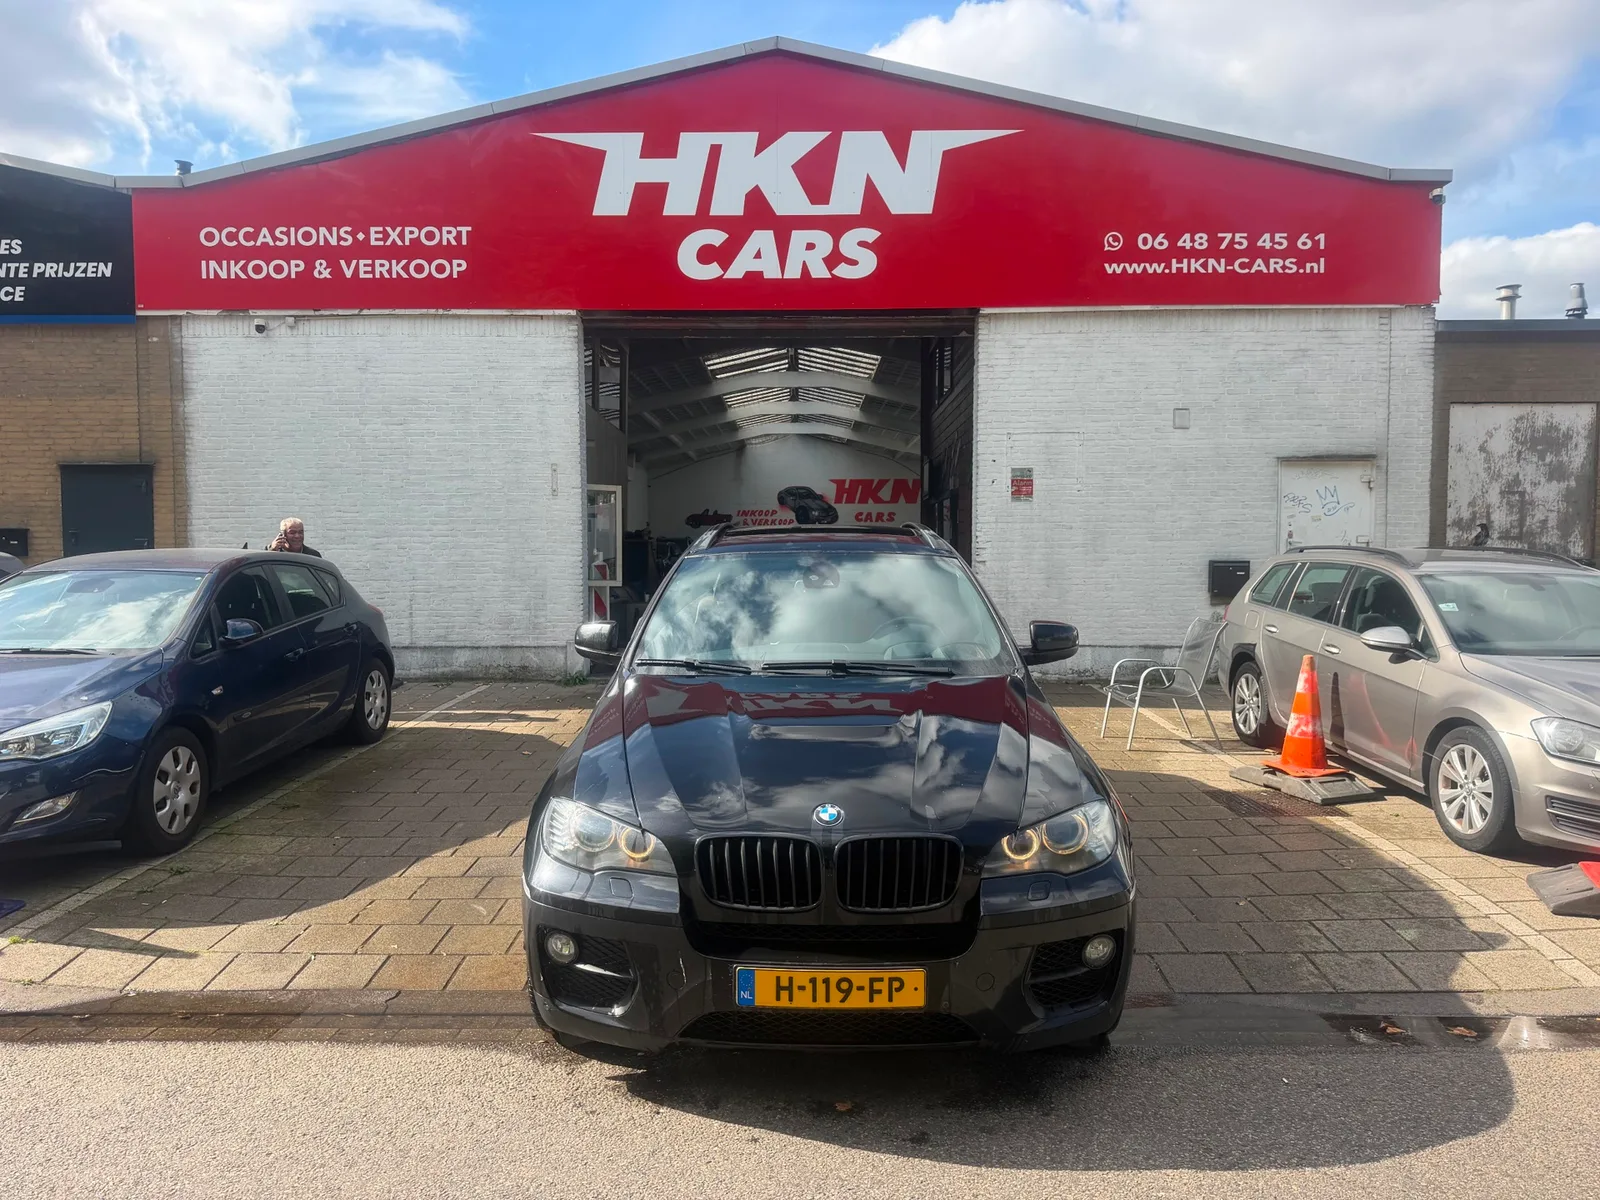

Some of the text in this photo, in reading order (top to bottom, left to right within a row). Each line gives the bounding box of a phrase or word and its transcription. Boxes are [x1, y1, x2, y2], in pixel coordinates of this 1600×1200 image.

[529, 129, 1025, 216] HKN
[199, 226, 472, 247] OCCASIONS EXPORT
[1137, 232, 1325, 250] 06 48 75 45 61
[677, 228, 882, 280] CARS
[32, 262, 113, 278] PRIJZEN
[200, 258, 468, 279] INKOOP & VERKOOP
[1103, 257, 1325, 274] www.HKN-CARS.nl
[829, 478, 921, 505] HKN
[736, 509, 778, 518] INKOOP
[751, 518, 796, 526] VERKOOP
[854, 511, 897, 523] CARS
[740, 990, 753, 1000] NL
[775, 976, 905, 1004] H-119-FP
